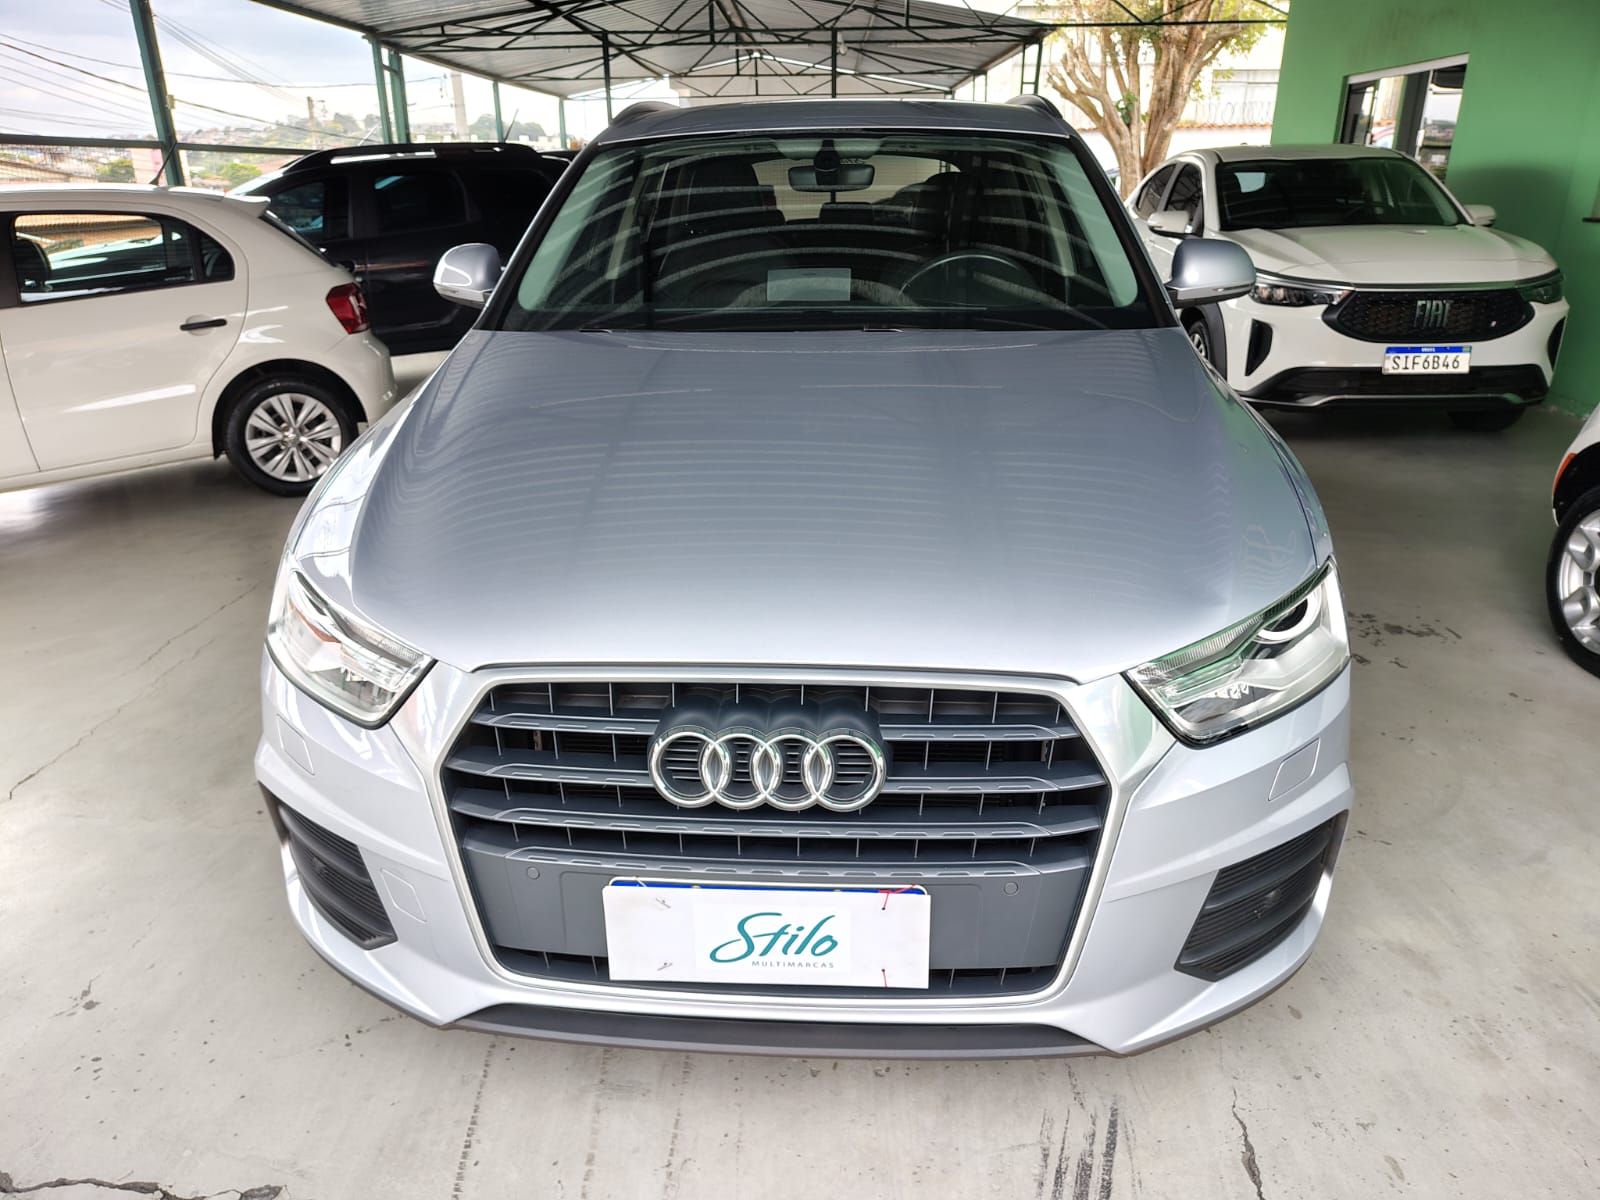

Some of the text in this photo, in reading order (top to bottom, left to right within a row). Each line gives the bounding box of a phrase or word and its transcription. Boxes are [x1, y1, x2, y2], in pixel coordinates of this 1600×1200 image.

[1413, 299, 1454, 328] FIAT
[1391, 355, 1461, 371] SIF6B46
[709, 911, 839, 963] Stilo
[751, 960, 835, 969] MULTIMARCAS
